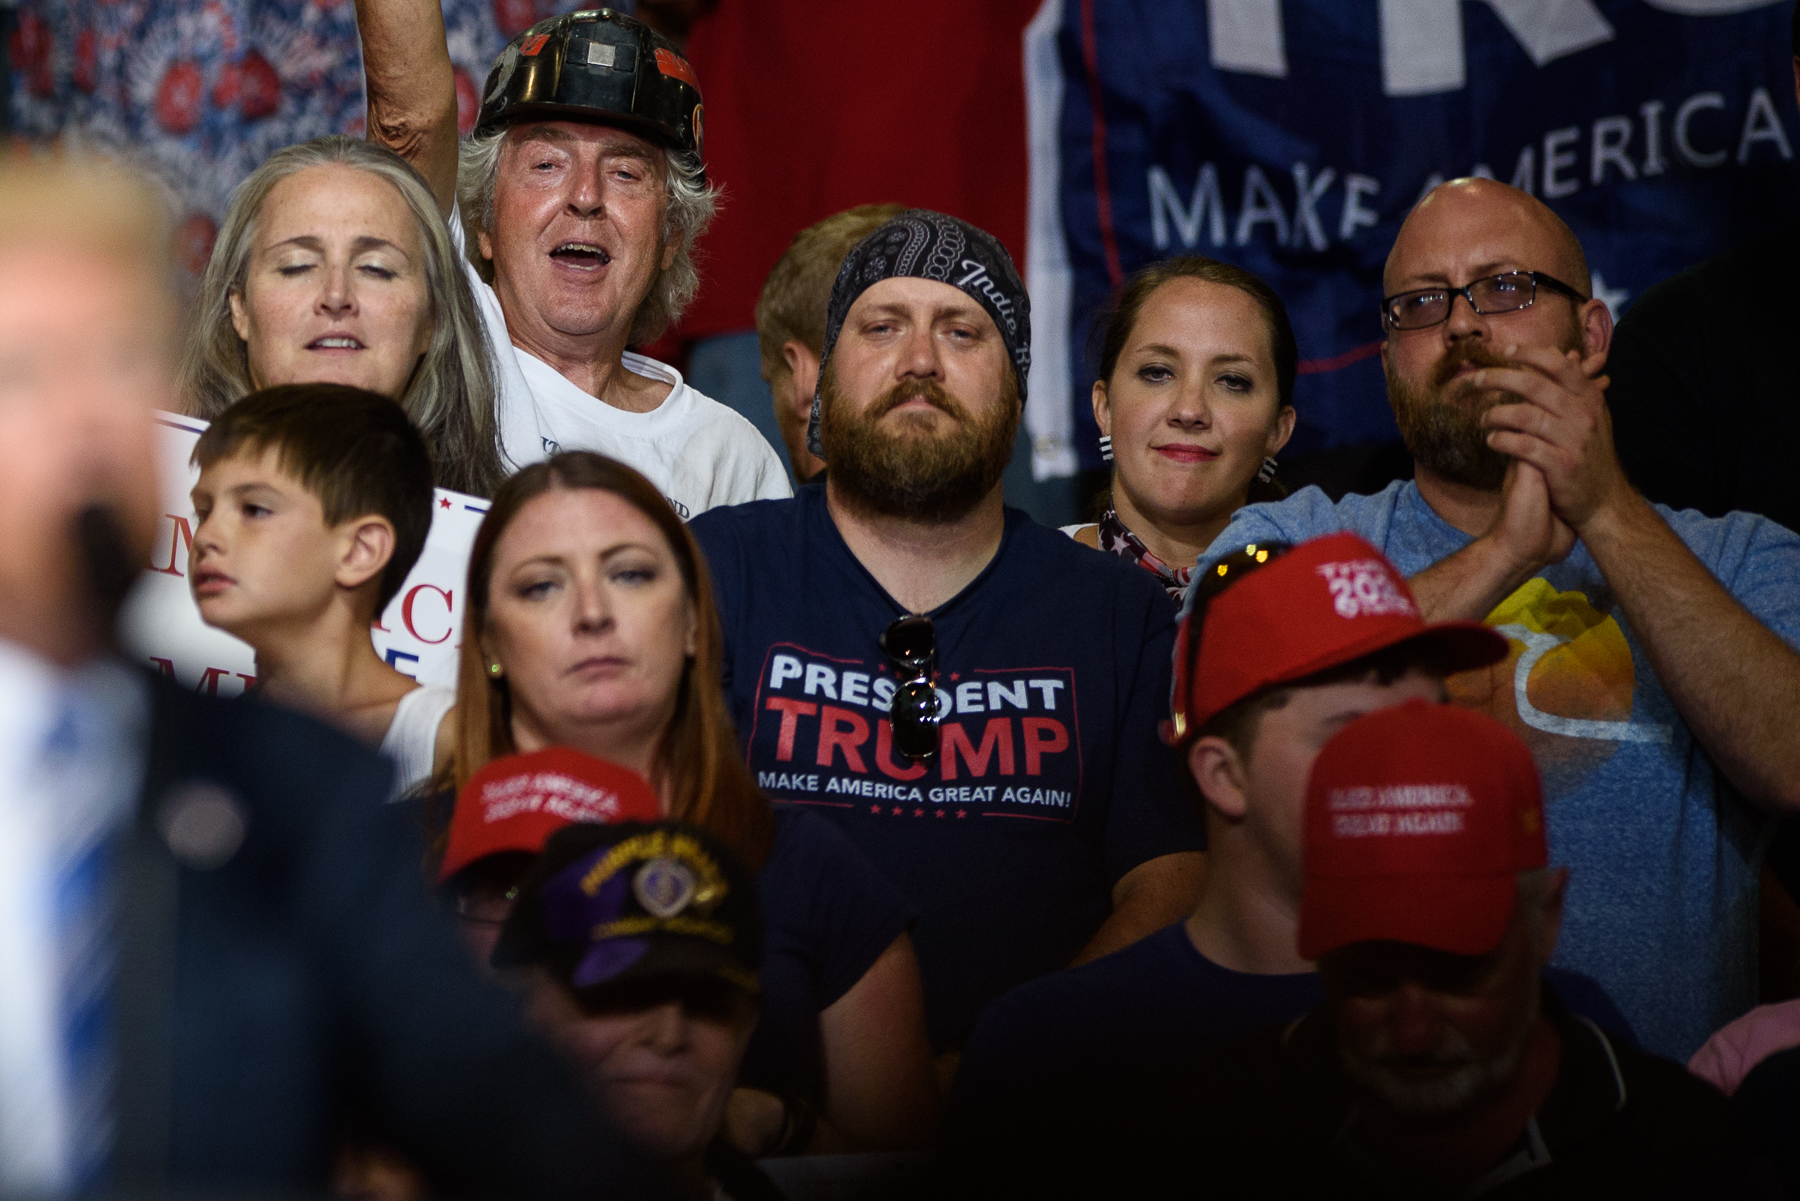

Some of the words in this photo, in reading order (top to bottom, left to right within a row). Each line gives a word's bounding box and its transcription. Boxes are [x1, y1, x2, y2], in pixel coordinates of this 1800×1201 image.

[957, 259, 1017, 336] Indie
[769, 653, 1064, 719] PRESDENT
[765, 695, 1070, 781] TRUMP
[758, 770, 819, 792] MAKE
[825, 777, 923, 802] AMERICA
[928, 785, 996, 804] GREAT
[1001, 787, 1072, 809] AGAIN!
